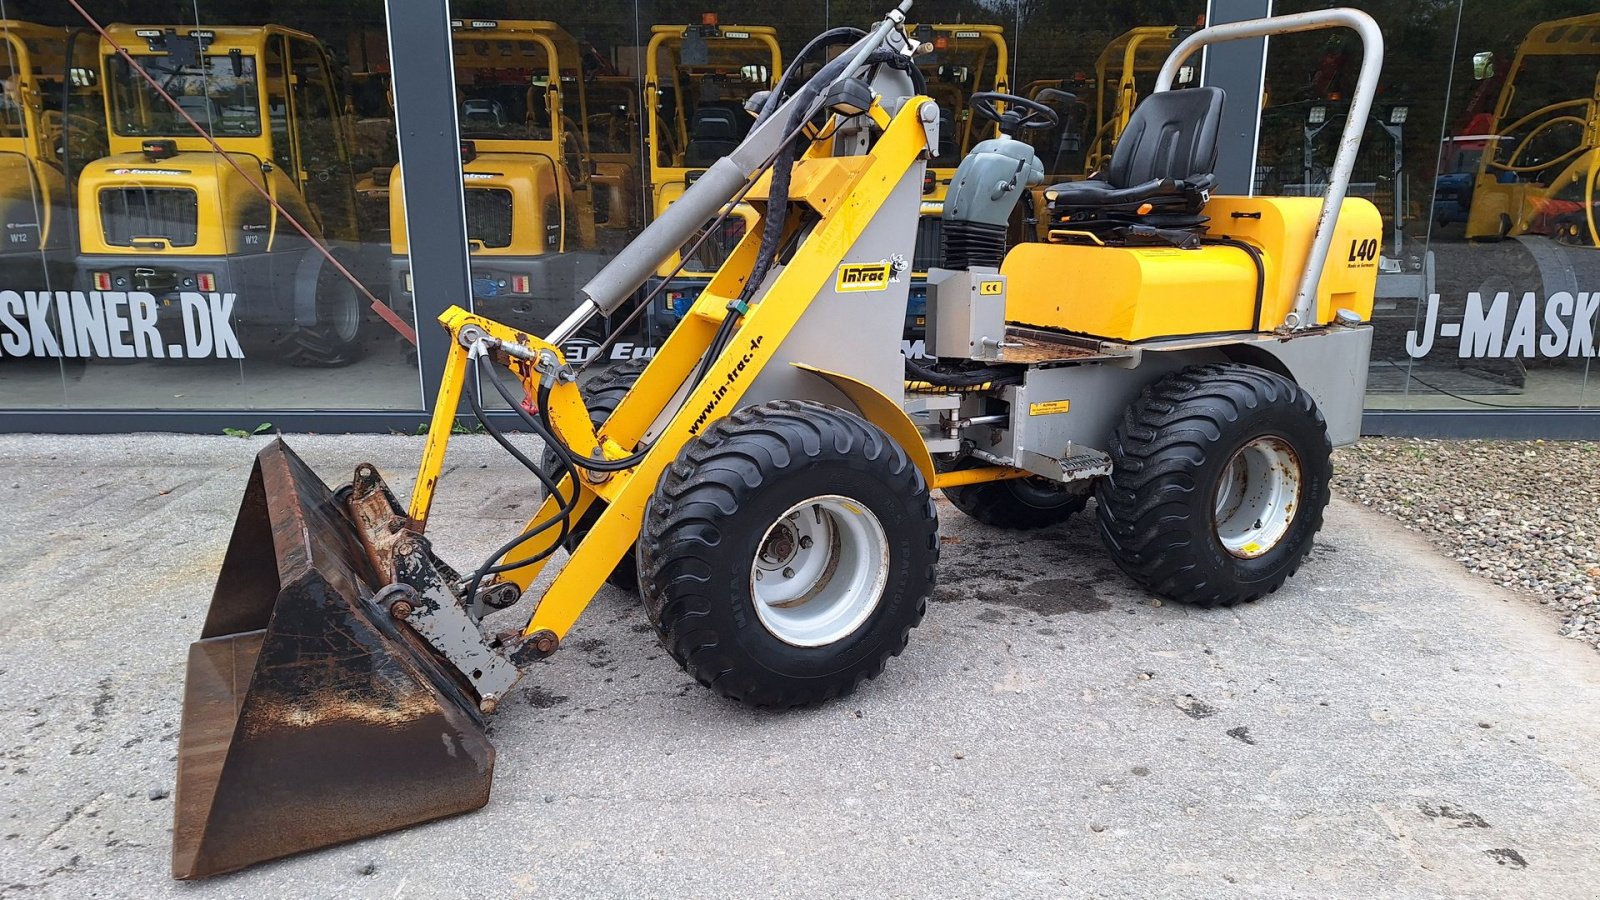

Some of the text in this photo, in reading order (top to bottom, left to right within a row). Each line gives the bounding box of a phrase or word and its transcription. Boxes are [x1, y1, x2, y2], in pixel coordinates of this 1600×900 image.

[10, 233, 28, 243] W12
[245, 235, 258, 245] W12
[1348, 238, 1378, 262] L40
[0, 290, 245, 359] SKINER.DK
[1405, 291, 1600, 358] J-MASK
[609, 342, 657, 360] Eu
